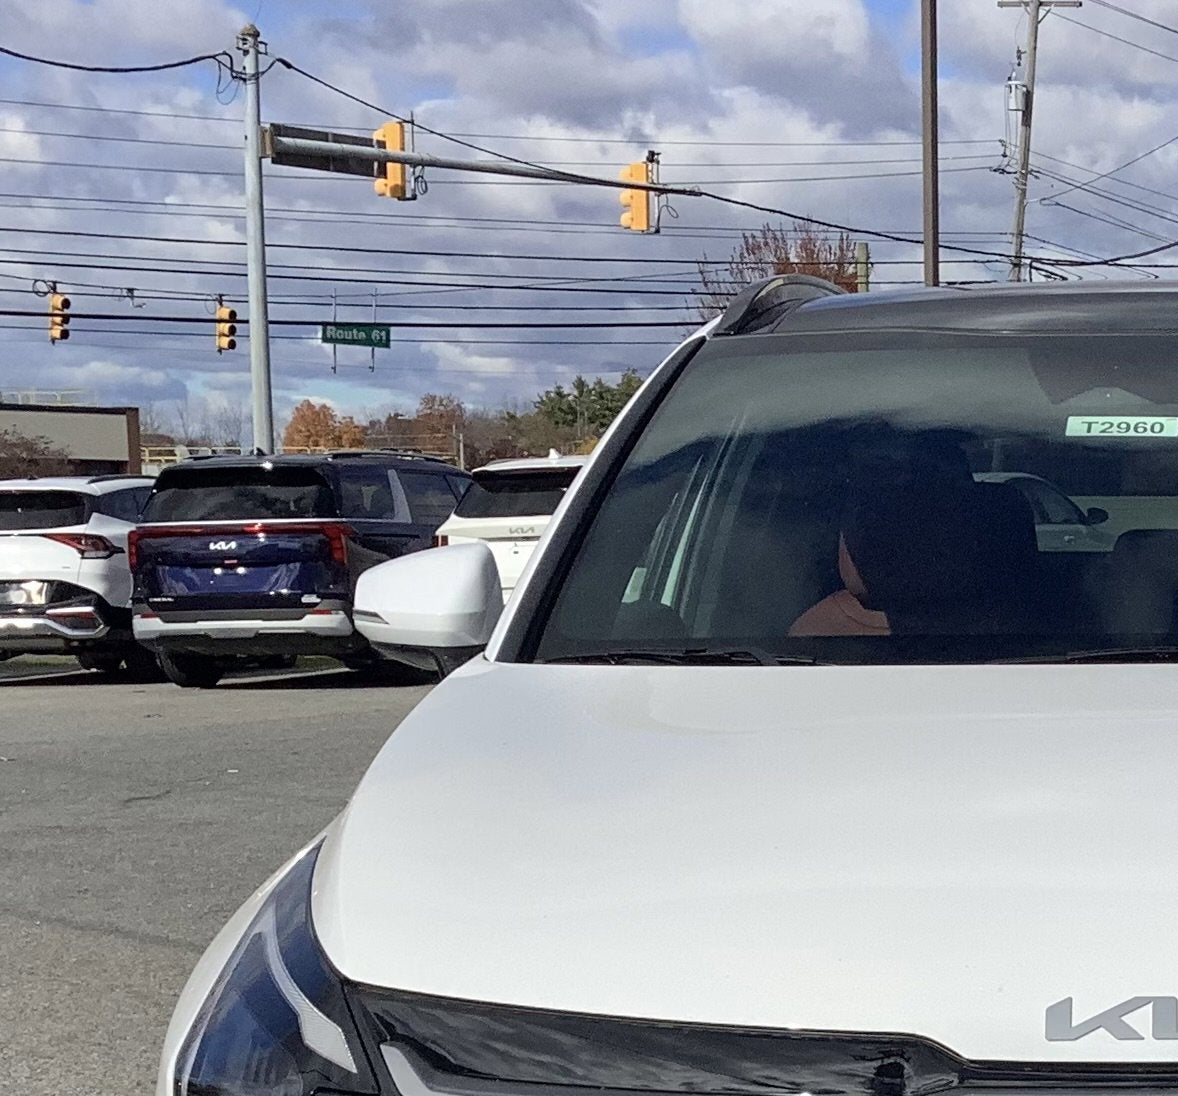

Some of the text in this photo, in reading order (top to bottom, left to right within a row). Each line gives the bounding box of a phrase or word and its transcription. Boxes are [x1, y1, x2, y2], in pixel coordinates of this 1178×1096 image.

[326, 325, 387, 344] Route 61
[1081, 421, 1165, 434] T2960
[209, 541, 237, 550] KIA
